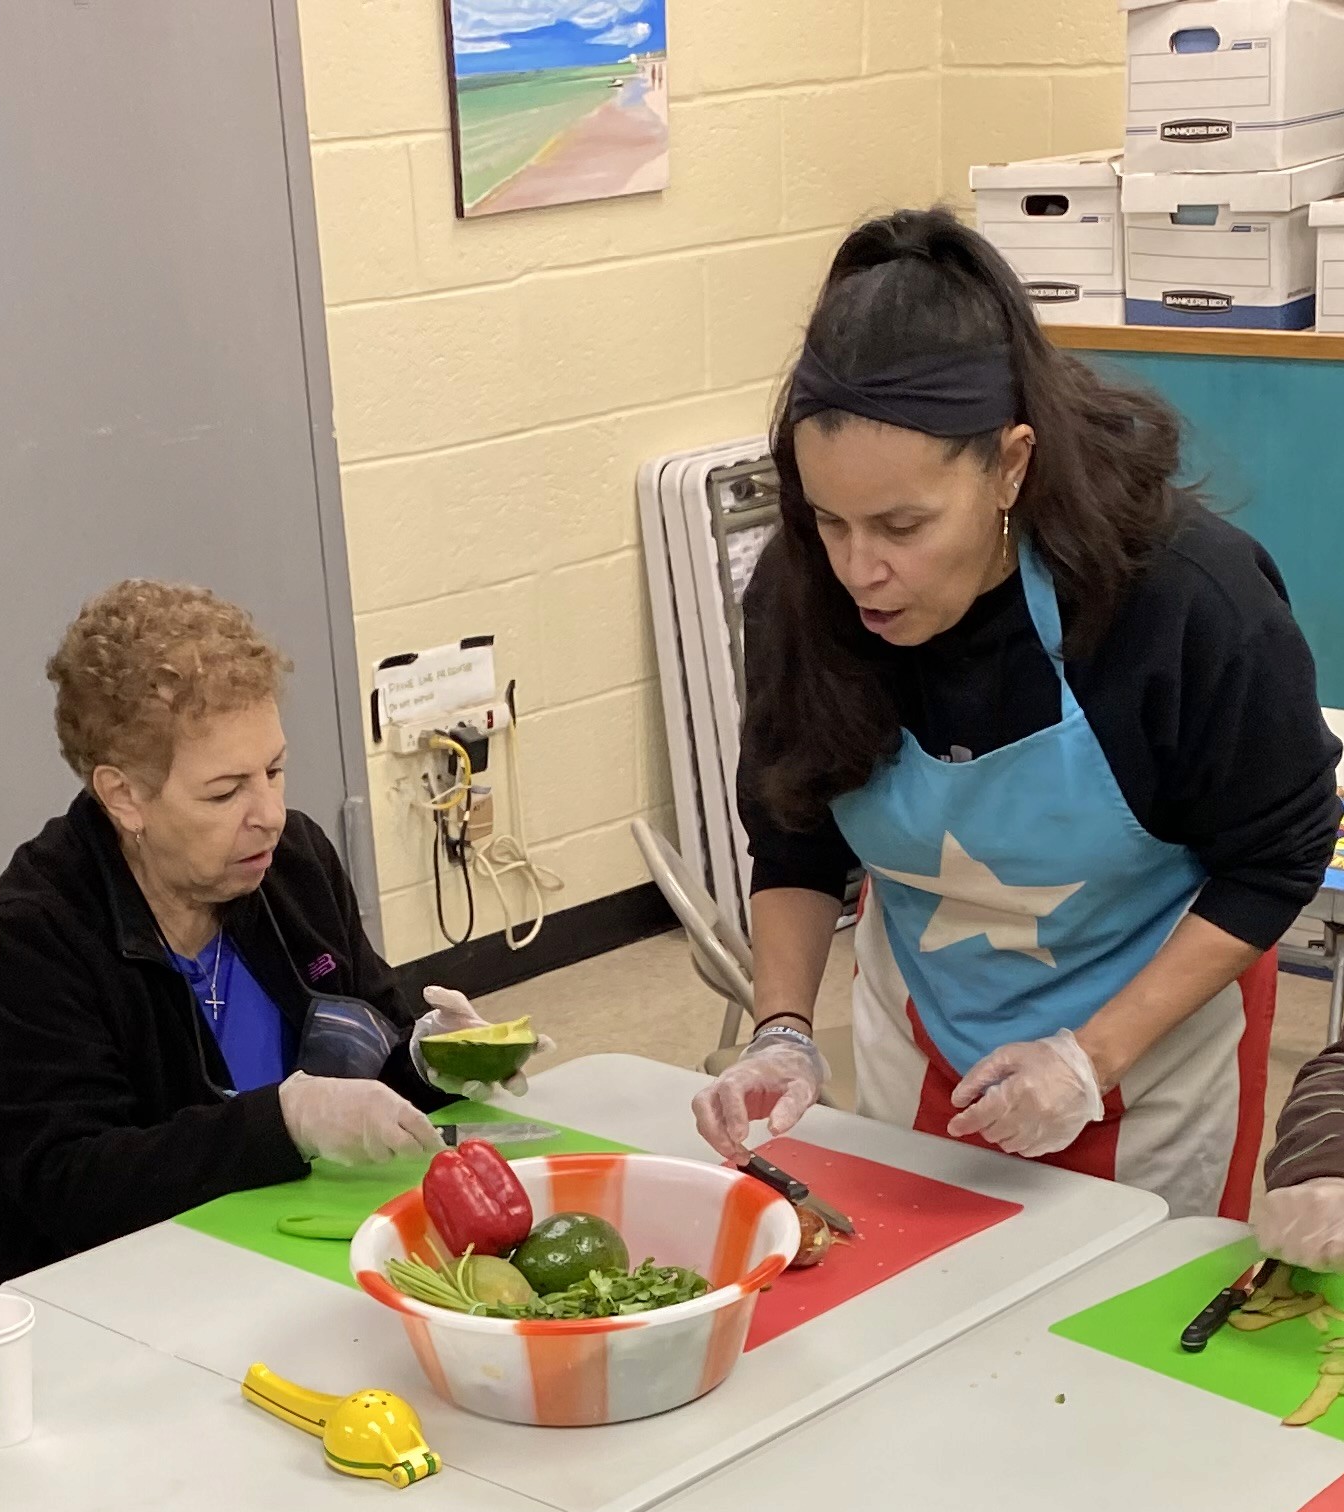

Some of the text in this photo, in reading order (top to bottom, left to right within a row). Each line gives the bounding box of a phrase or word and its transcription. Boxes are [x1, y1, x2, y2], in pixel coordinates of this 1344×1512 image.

[1164, 125, 1229, 136] BANKERS BOX
[1166, 296, 1228, 307] BANKERS BOX
